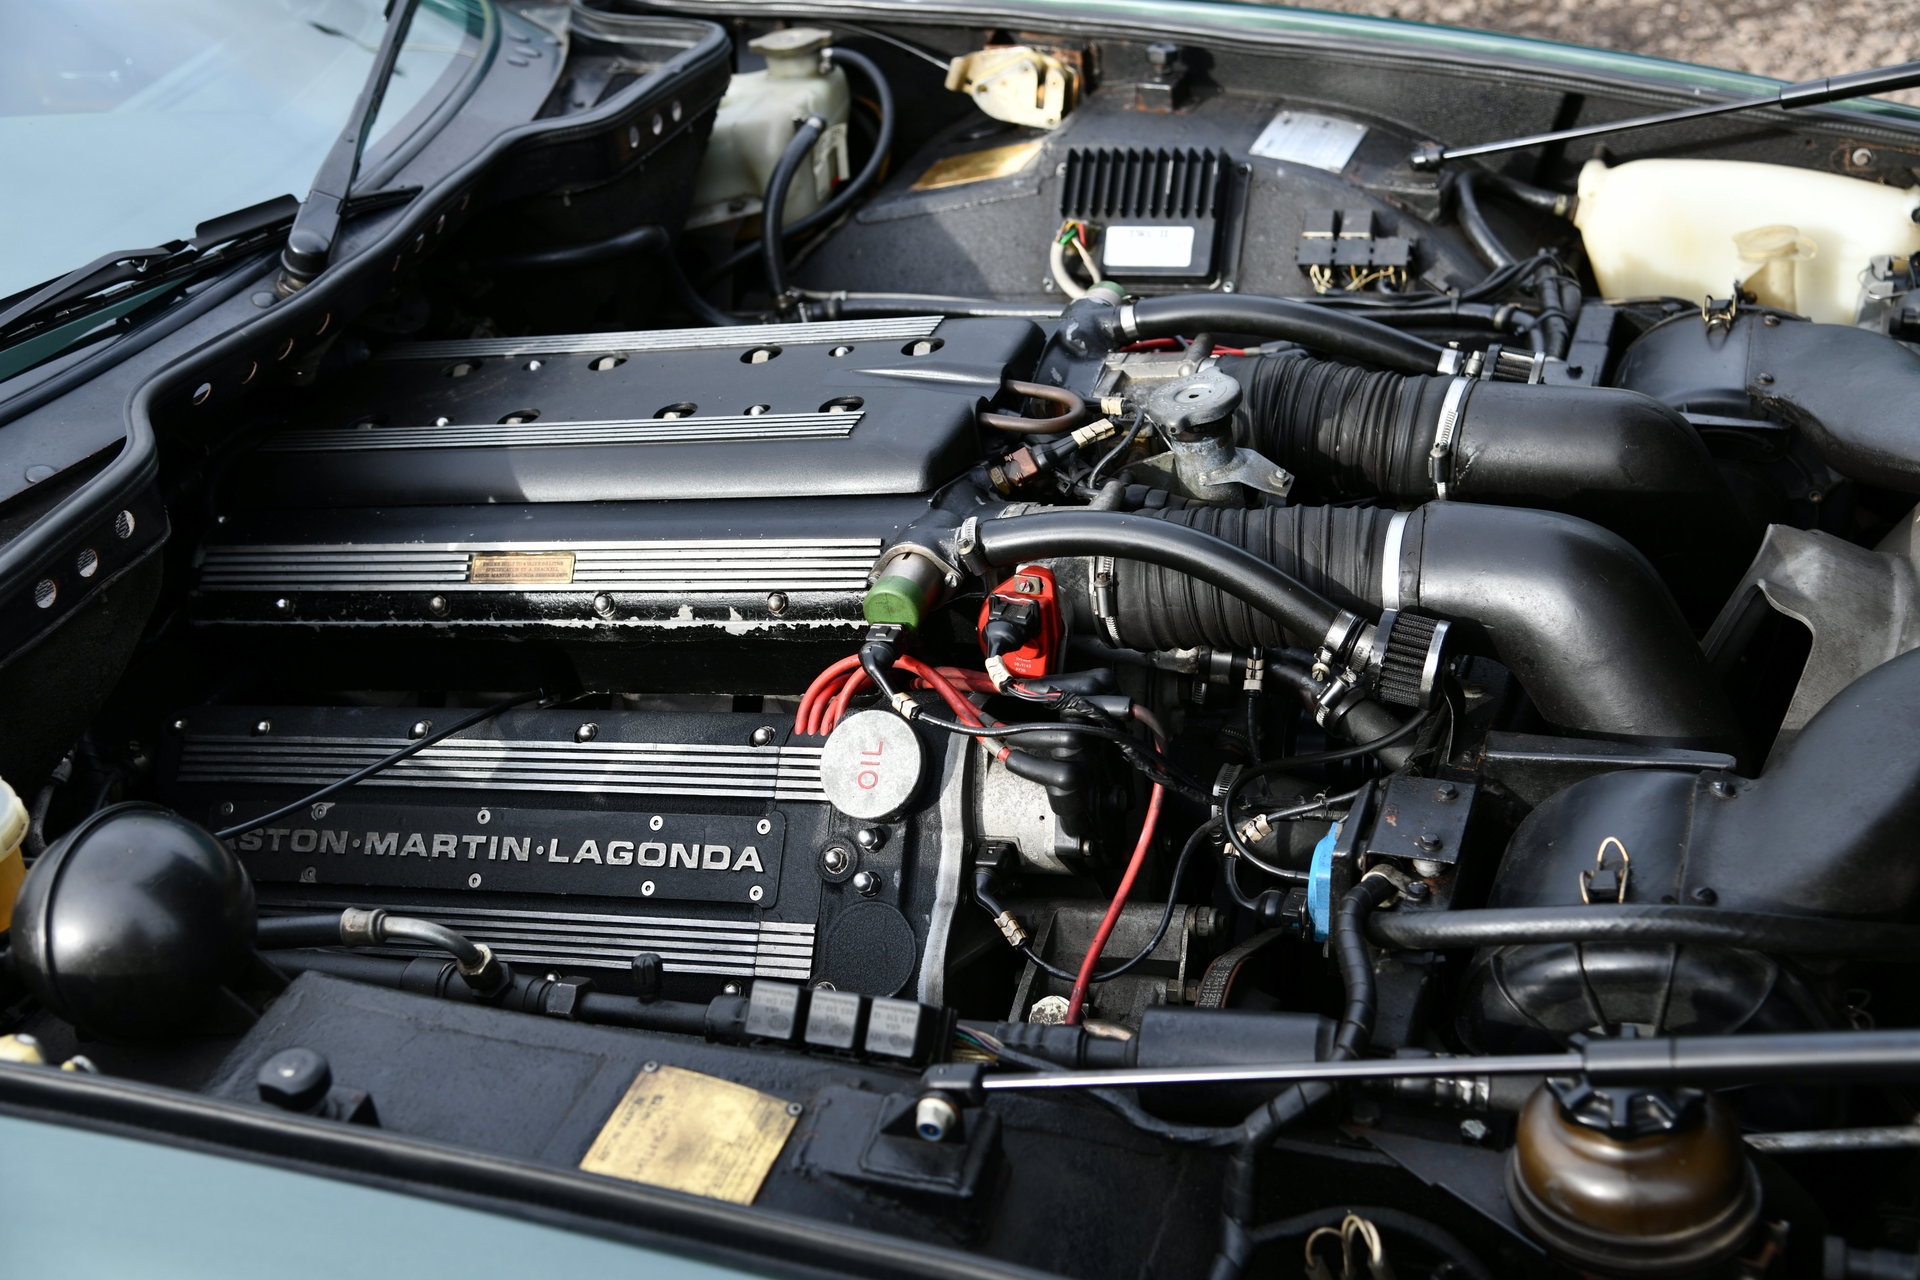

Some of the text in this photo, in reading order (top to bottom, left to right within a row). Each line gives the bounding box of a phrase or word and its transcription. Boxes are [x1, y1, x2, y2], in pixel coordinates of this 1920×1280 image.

[858, 741, 883, 789] OIL
[363, 832, 531, 862] MARTIN
[548, 838, 764, 873] LAGONDA
